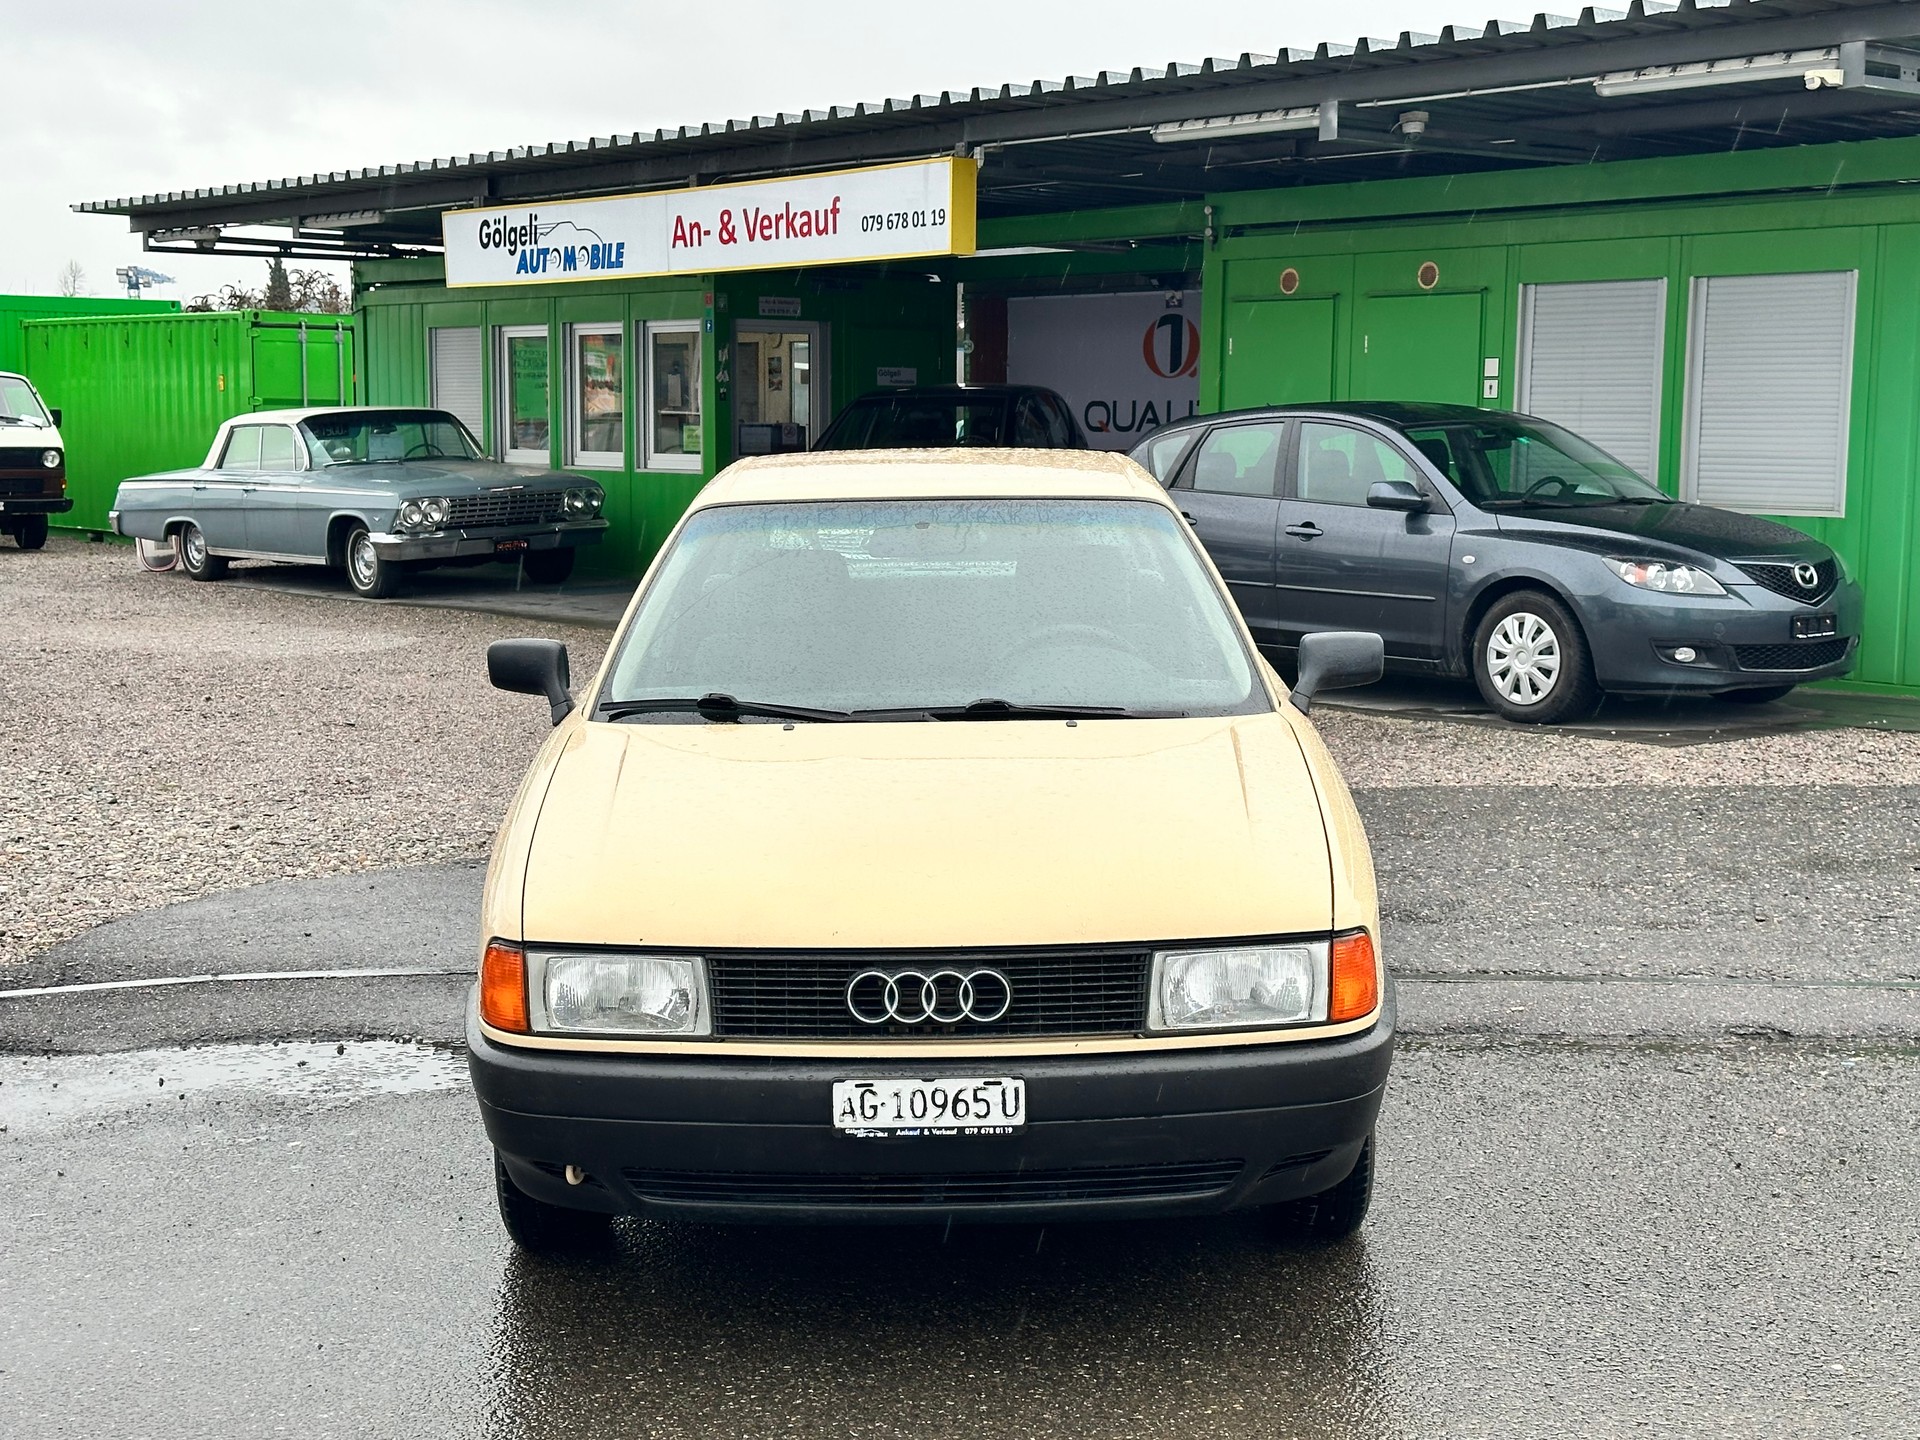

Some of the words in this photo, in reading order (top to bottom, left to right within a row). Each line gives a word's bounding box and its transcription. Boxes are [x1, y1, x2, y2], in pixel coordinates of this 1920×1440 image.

[479, 213, 538, 256] Gölgeli
[671, 214, 711, 249] An-
[718, 209, 738, 245] &
[742, 196, 841, 242] Verkauf
[861, 214, 884, 233] 079
[886, 211, 909, 231] 678
[911, 210, 927, 228] 01
[930, 208, 946, 226] 19
[896, 1128, 920, 1136] Ankauf
[923, 1128, 930, 1136] &
[931, 1128, 958, 1136] Verkauf
[965, 1127, 978, 1135] 079
[980, 1127, 994, 1135] 678
